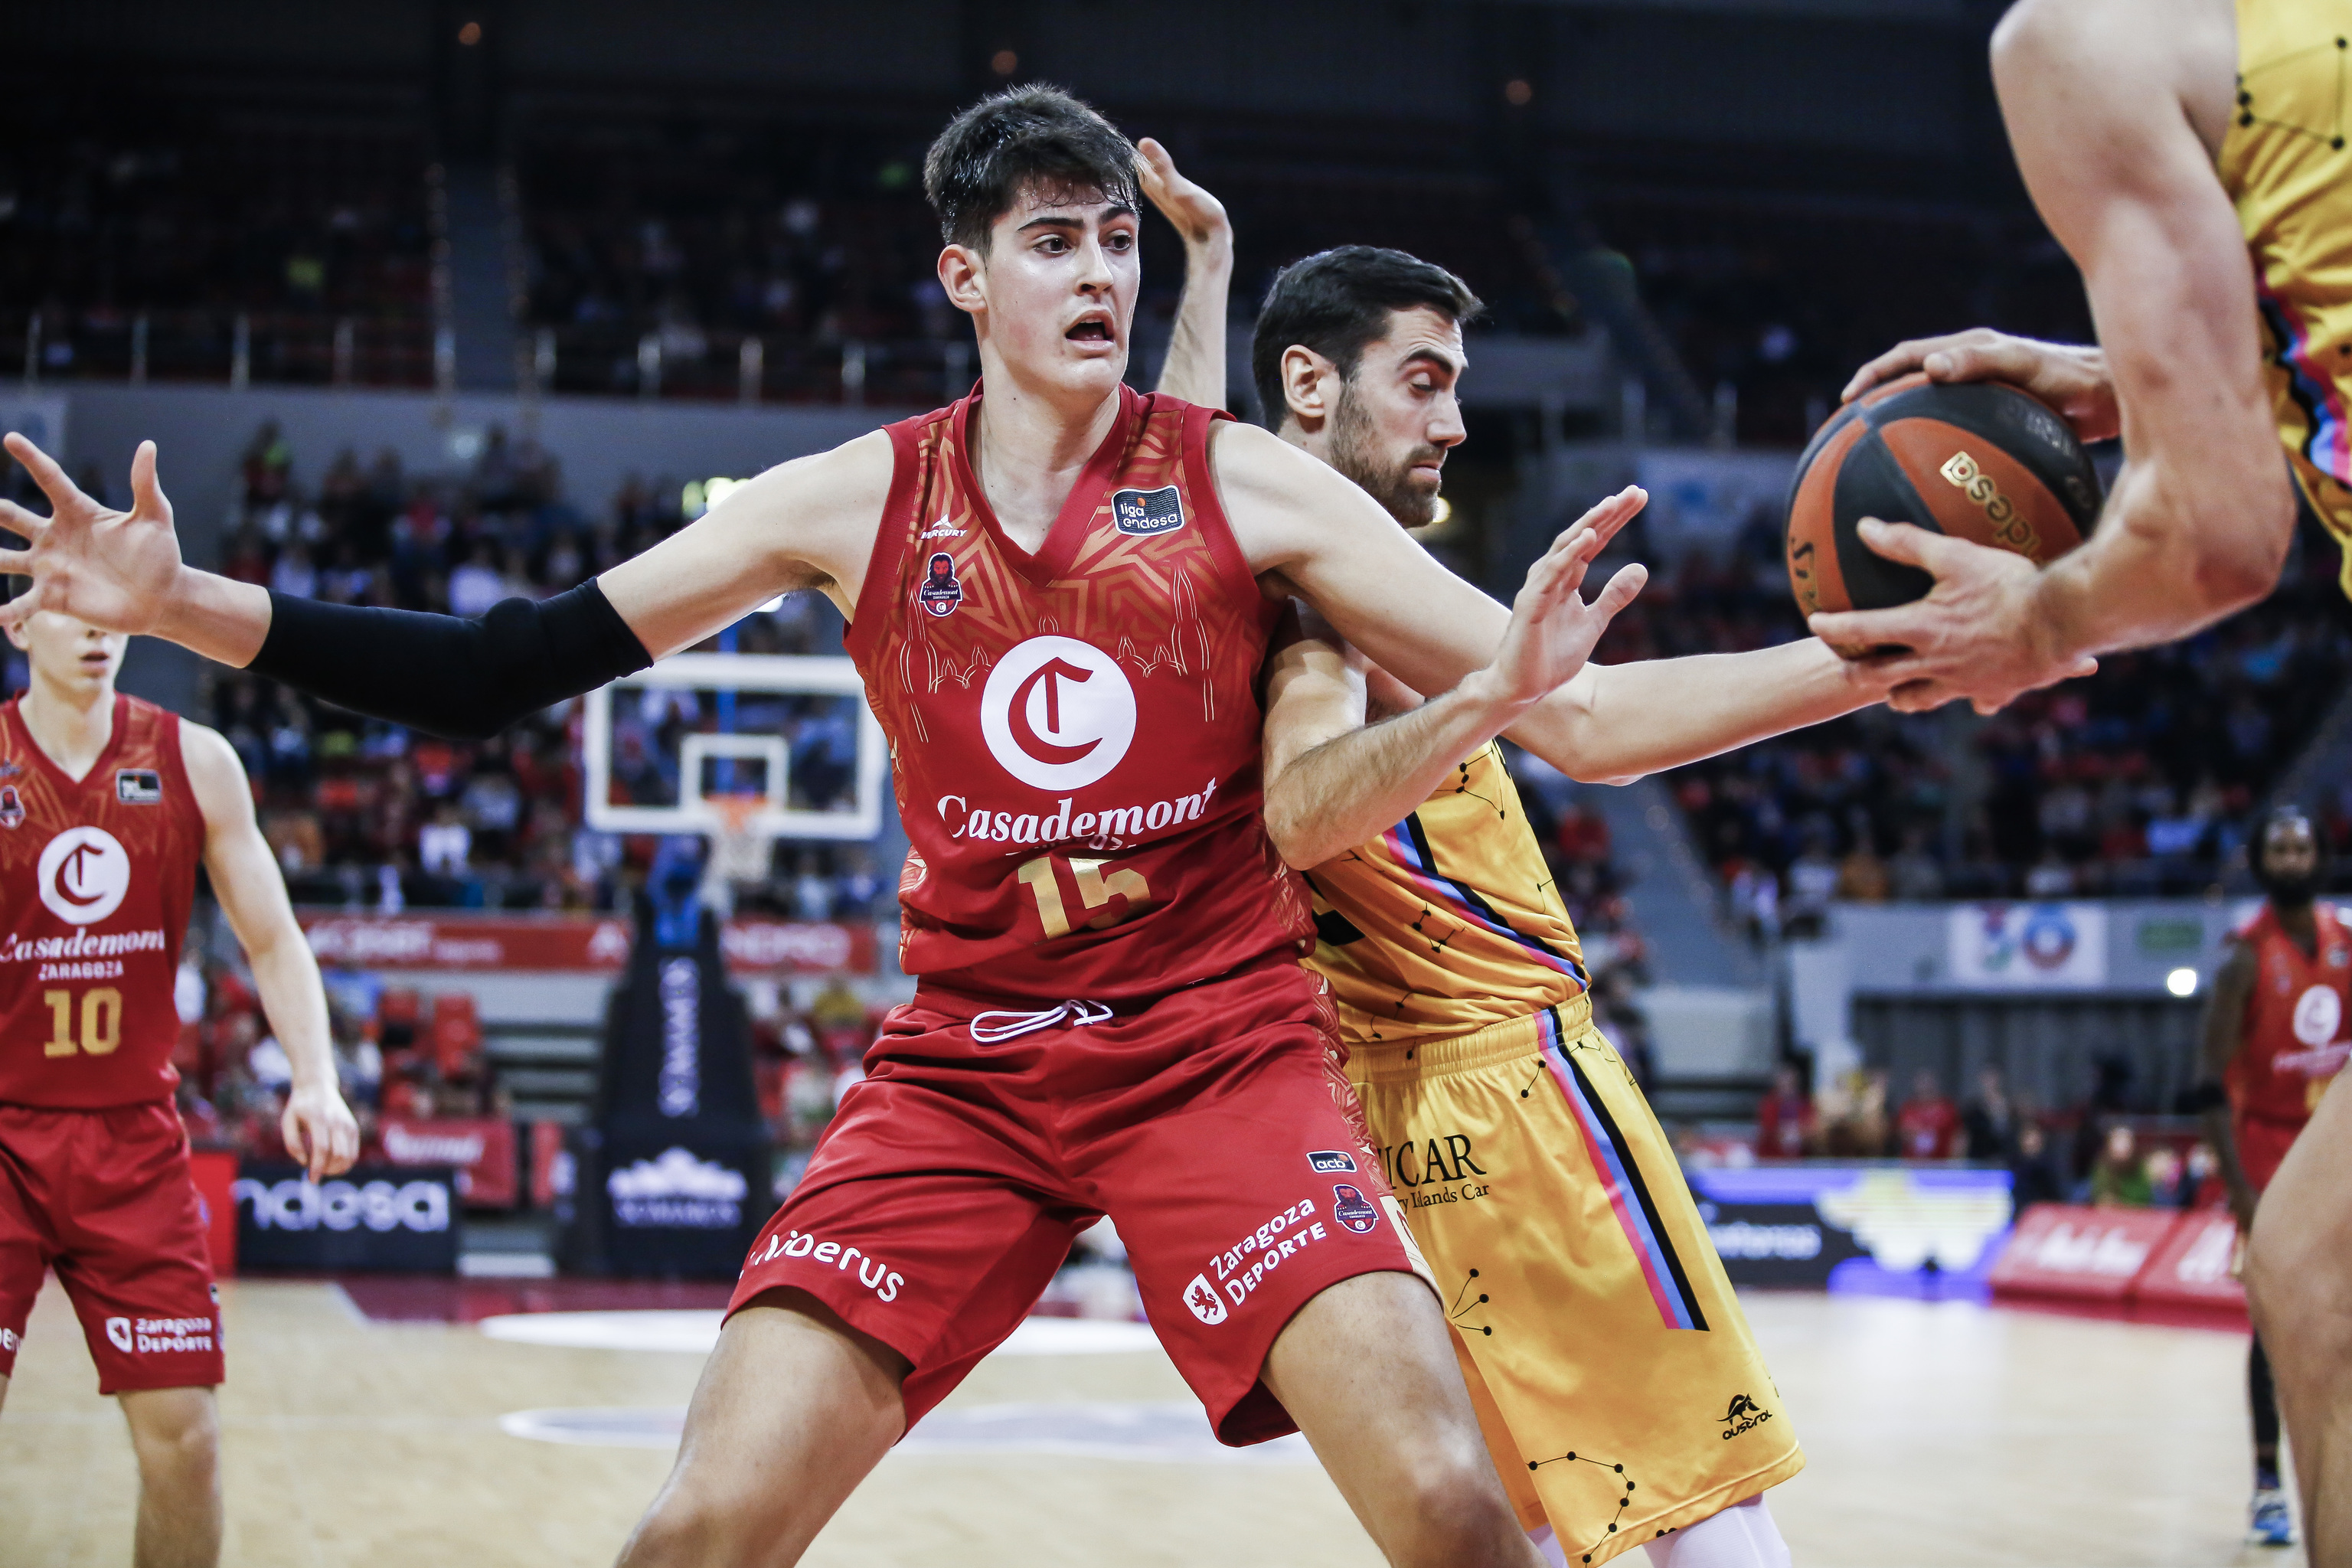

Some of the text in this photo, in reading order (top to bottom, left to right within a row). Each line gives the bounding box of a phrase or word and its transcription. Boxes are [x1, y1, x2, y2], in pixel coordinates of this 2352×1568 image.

[1120, 502, 1145, 518] liga
[1123, 513, 1178, 529] endesa
[1939, 451, 2047, 565] desa
[937, 776, 1217, 843] Casademont
[1018, 856, 1152, 940] 15
[44, 986, 122, 1059] 10
[1316, 1158, 1346, 1169] acb
[1462, 1184, 1489, 1200] Car
[1209, 1198, 1316, 1281] Zaragoza
[1224, 1220, 1328, 1307] DEPORTE
